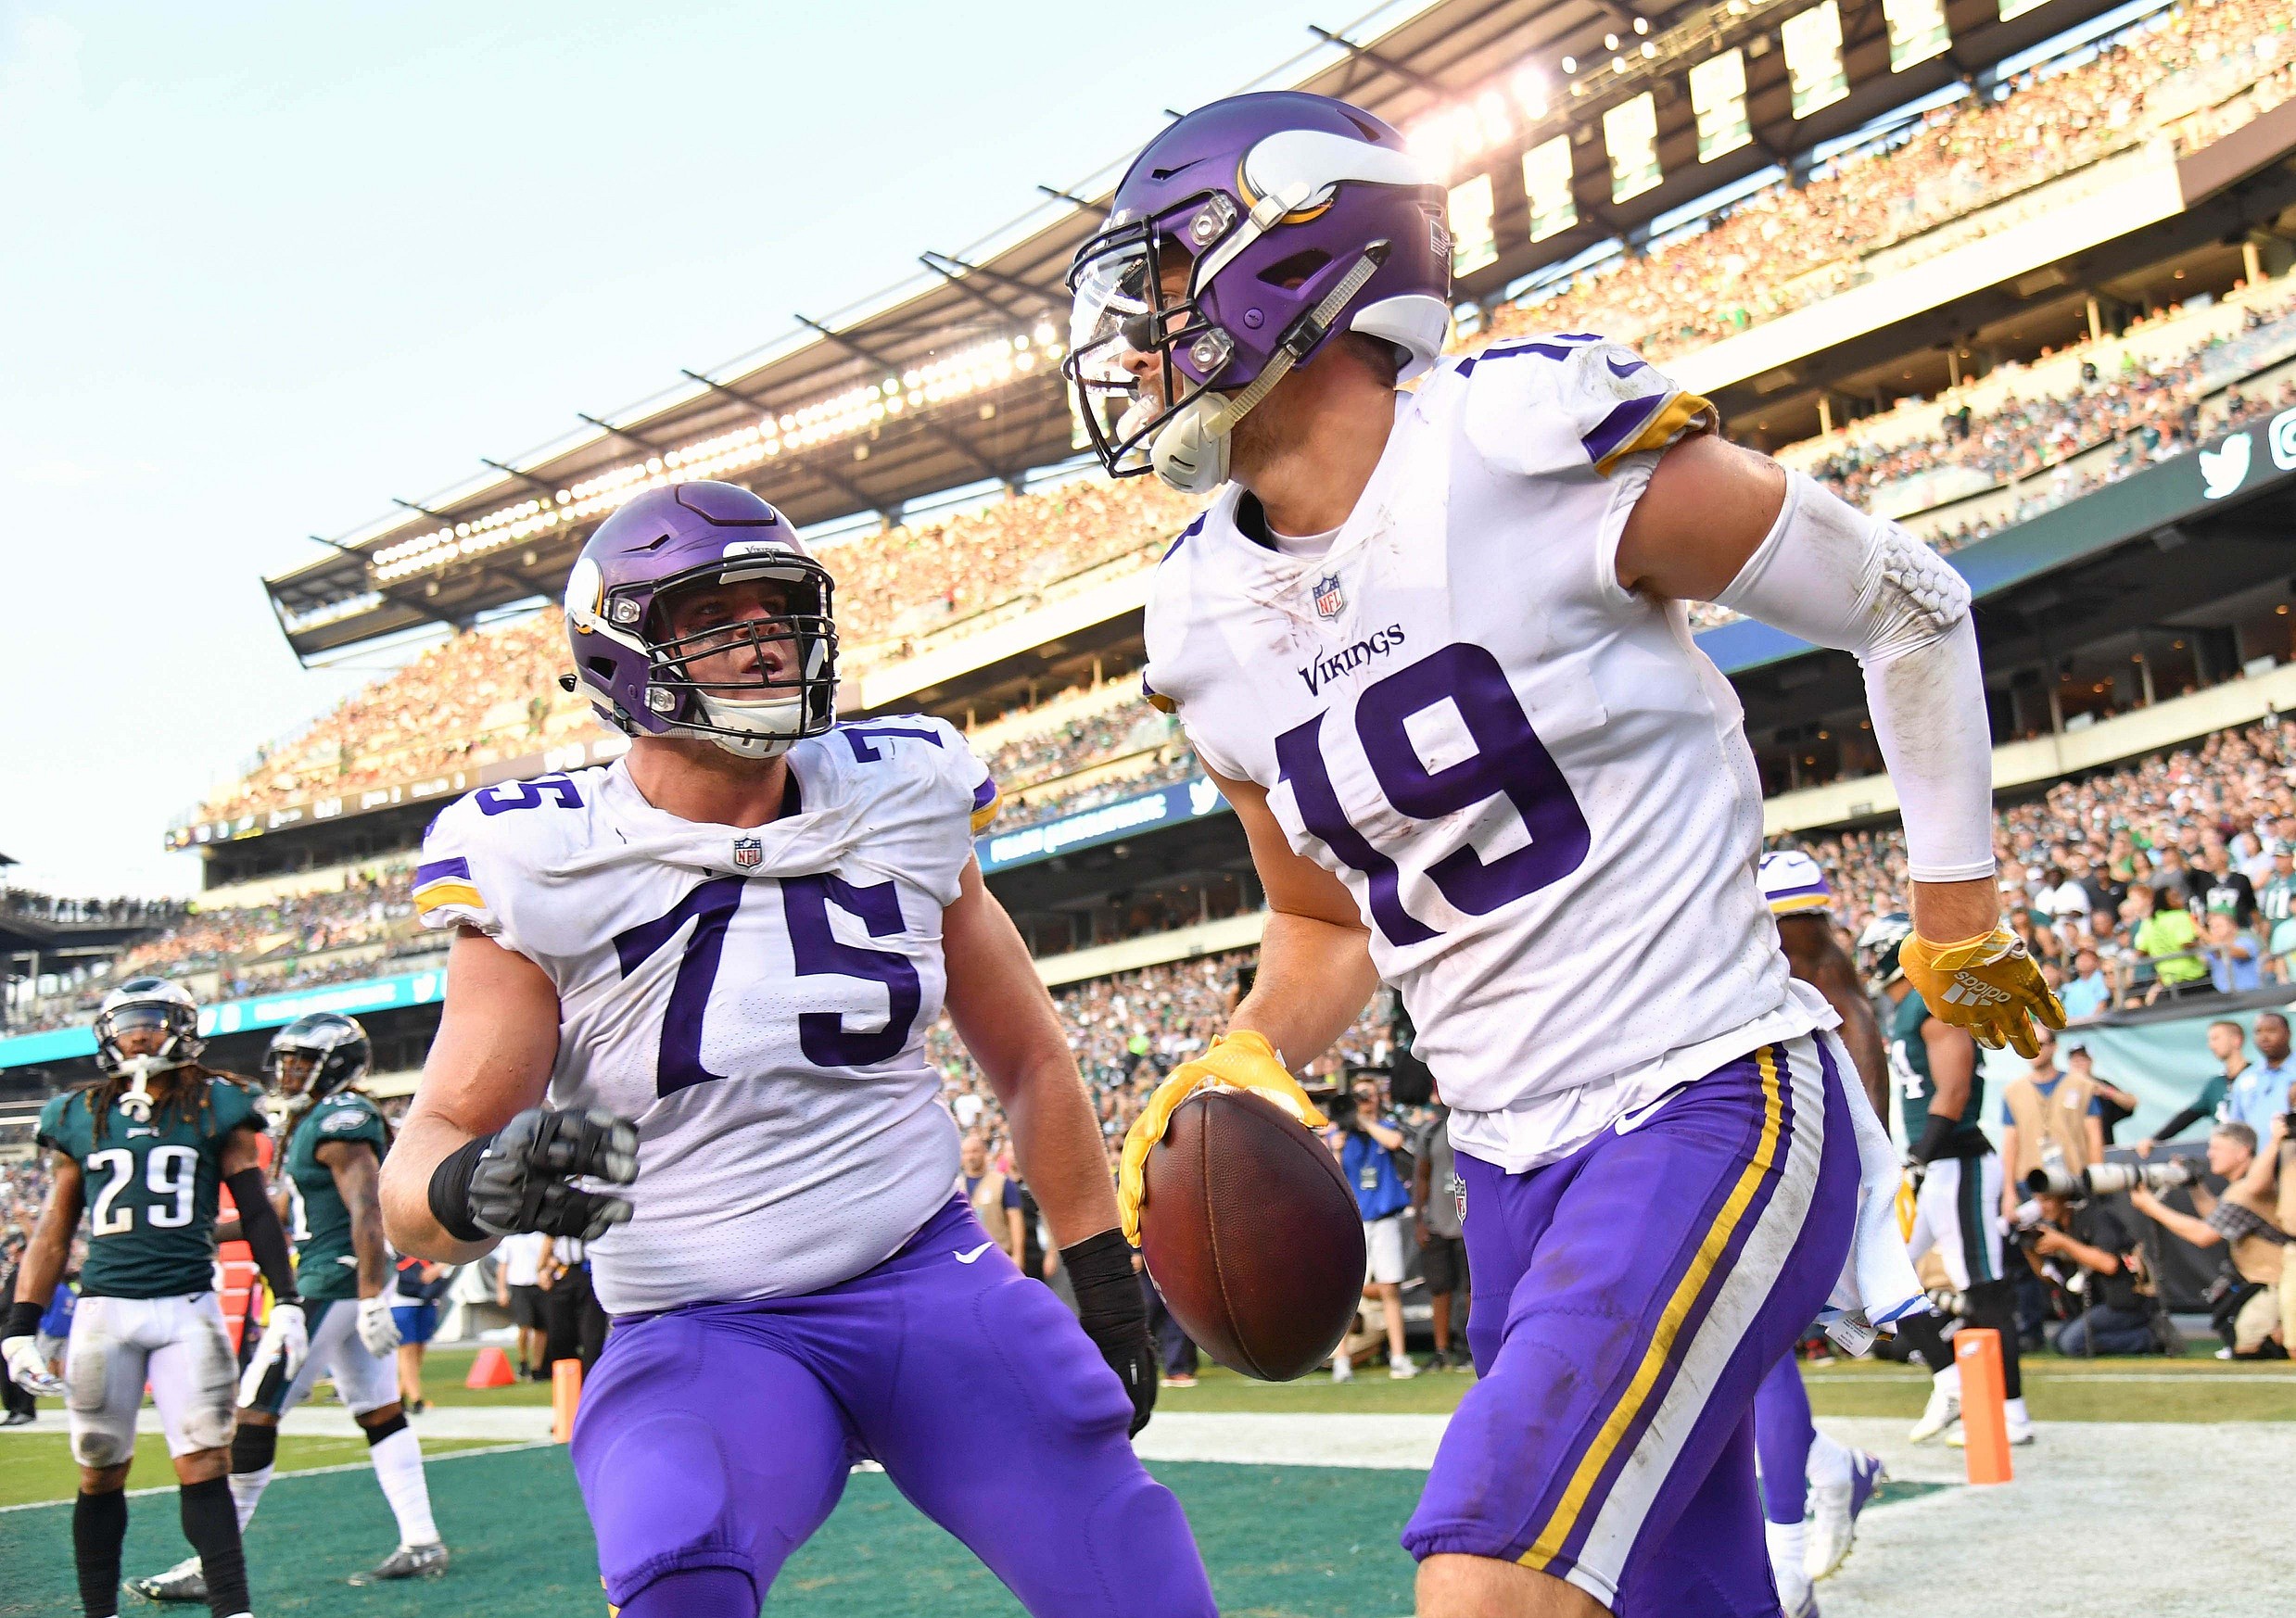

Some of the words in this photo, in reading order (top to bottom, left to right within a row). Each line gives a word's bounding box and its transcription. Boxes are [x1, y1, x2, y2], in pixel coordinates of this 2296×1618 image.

[1318, 591, 1341, 613] NFL
[1298, 623, 1405, 697] VIKINGS
[1275, 642, 1592, 946] 19
[738, 850, 760, 864] NFL
[613, 874, 921, 1098] 75
[1954, 971, 2011, 1003] adidas
[87, 1144, 199, 1237] 29
